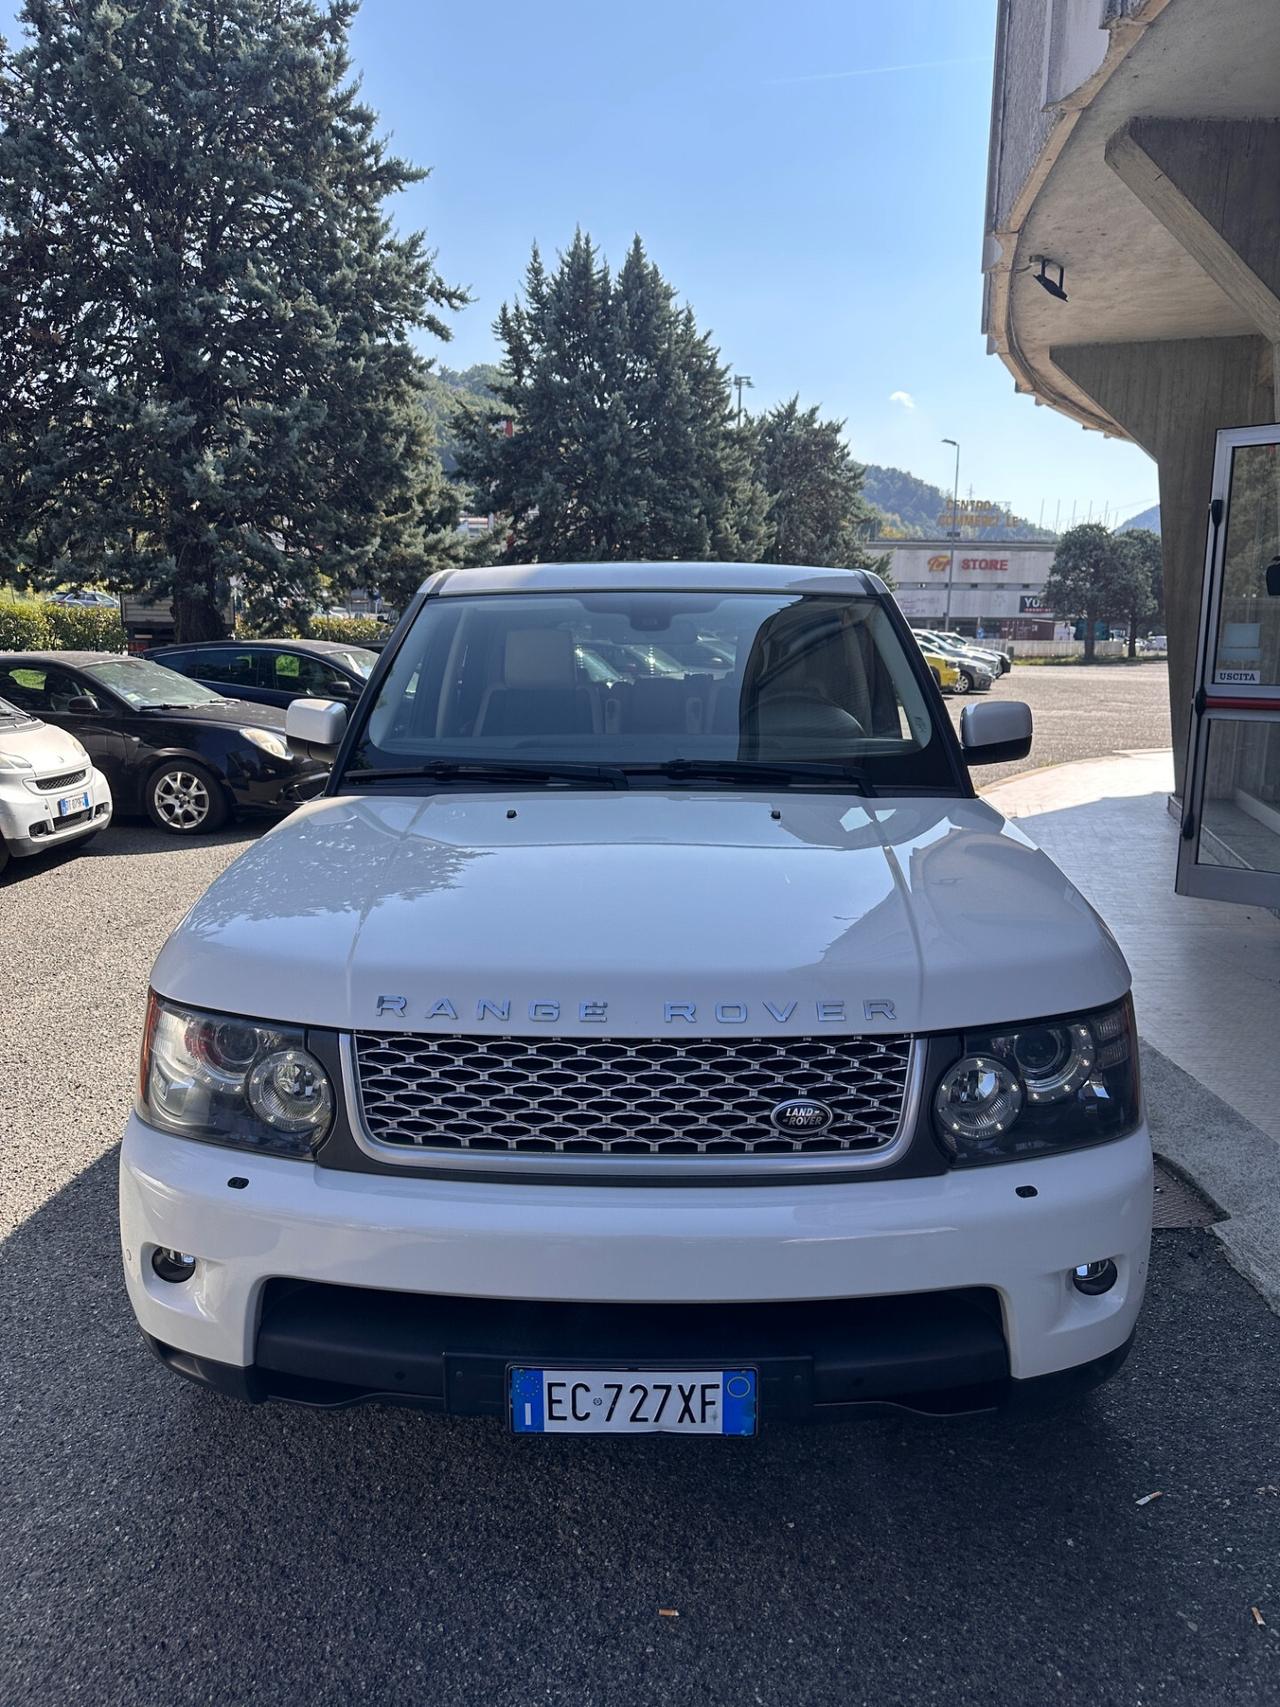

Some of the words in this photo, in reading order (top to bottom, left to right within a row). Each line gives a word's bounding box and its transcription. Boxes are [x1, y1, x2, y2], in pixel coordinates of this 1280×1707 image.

[961, 558, 1009, 571] STORE
[1219, 673, 1256, 681] USCITA
[376, 994, 608, 1023] RANGE
[663, 998, 897, 1024] ROVER
[785, 1107, 814, 1117] LAND
[788, 1116, 824, 1126] ROVER
